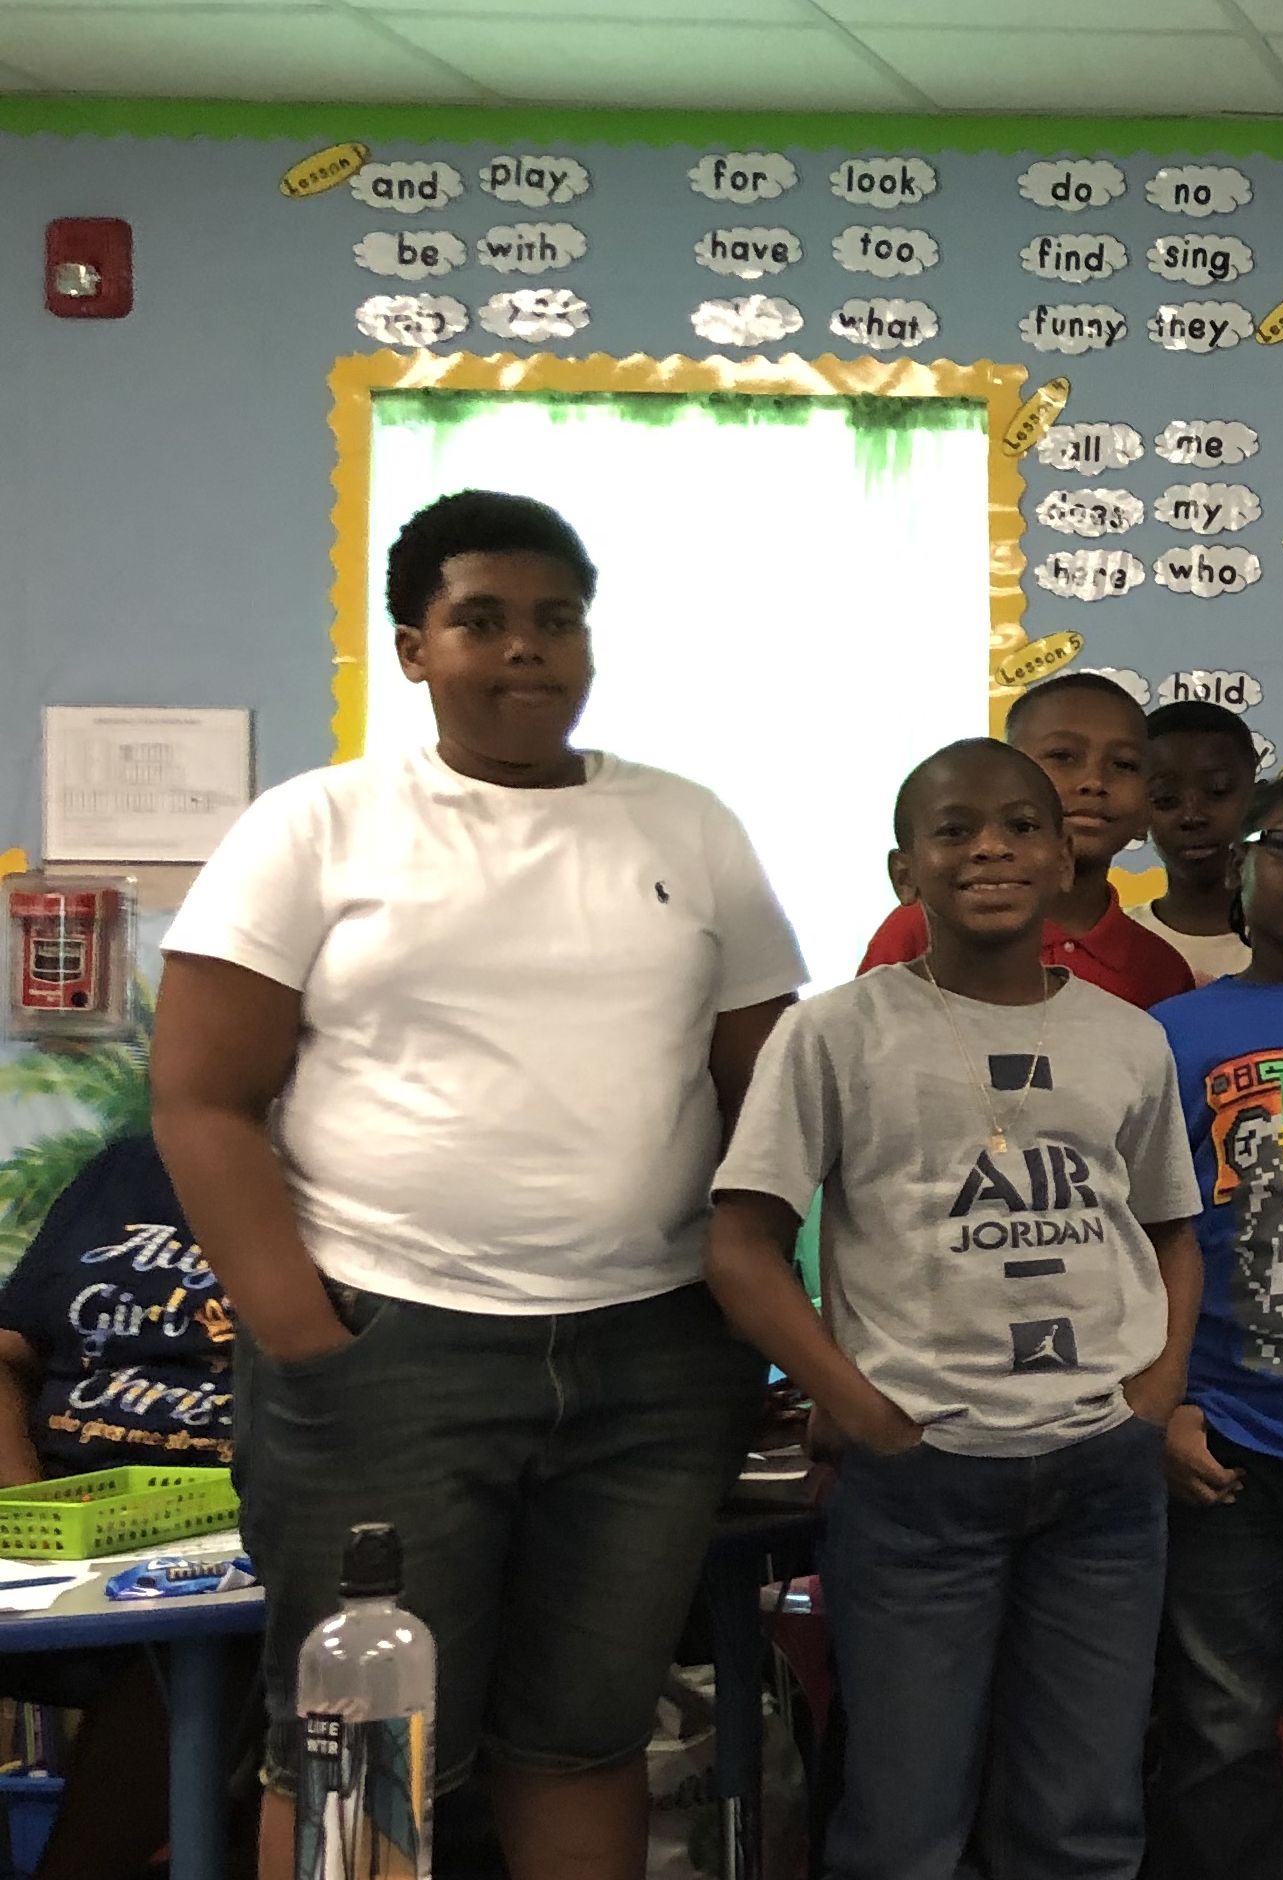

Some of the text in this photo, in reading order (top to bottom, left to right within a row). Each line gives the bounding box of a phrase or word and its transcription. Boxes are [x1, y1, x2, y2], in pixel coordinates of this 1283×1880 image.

[284, 158, 351, 195] Lesson
[371, 171, 438, 200] and
[490, 160, 568, 200] play
[714, 159, 767, 191] for
[846, 165, 916, 196] look
[1051, 172, 1092, 203] do
[1175, 183, 1211, 205] no
[398, 233, 439, 267] be
[486, 232, 557, 261] with
[711, 231, 789, 263] have
[860, 232, 914, 263] too
[1038, 238, 1104, 272] find
[1164, 239, 1230, 279] sing
[838, 307, 919, 340] what
[1036, 304, 1124, 347] funny
[1155, 312, 1228, 347] they
[1060, 435, 1100, 462] all
[1176, 435, 1223, 458] me
[1174, 500, 1222, 530] my
[1169, 553, 1237, 584] who
[1000, 634, 1081, 684] Lesson 5
[1173, 672, 1246, 705] hold
[949, 1144, 1099, 1218] AIR
[949, 1216, 1105, 1254] JORDAN
[69, 1282, 190, 1357] Girl
[307, 1719, 340, 1736] LIFE
